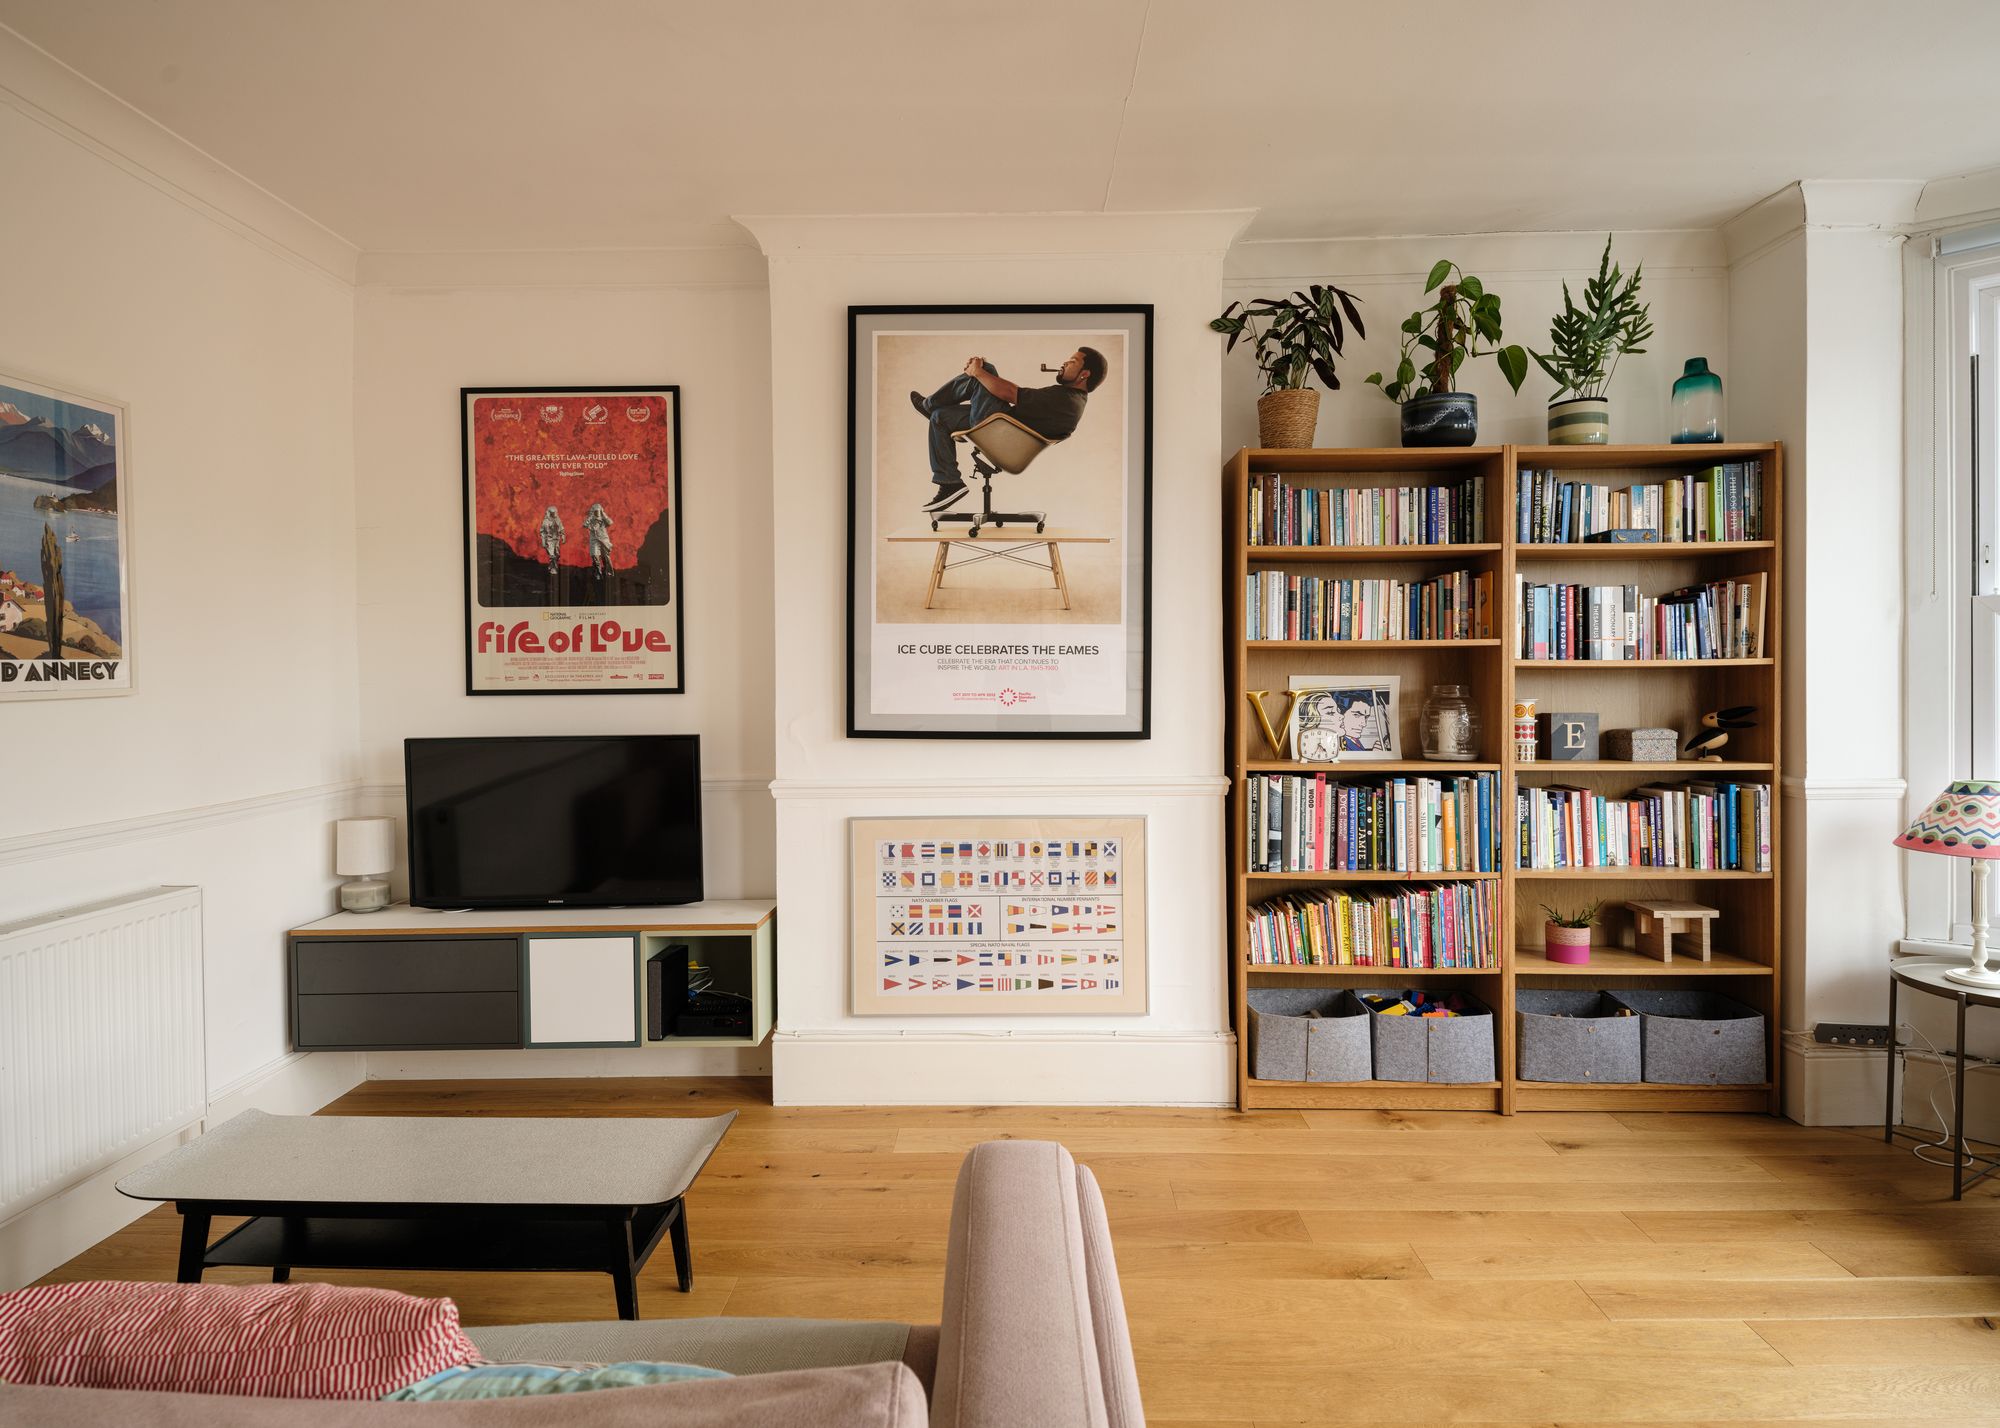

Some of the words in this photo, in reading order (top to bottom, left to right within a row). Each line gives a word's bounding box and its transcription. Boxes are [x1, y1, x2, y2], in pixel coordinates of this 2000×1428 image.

[549, 624, 583, 653] of
[898, 645, 916, 654] ICE
[920, 645, 952, 654] CUBE
[955, 645, 1029, 654] CELEBRATES
[1032, 645, 1055, 654] THE
[1059, 646, 1099, 655] EAMES
[1564, 721, 1586, 749] E
